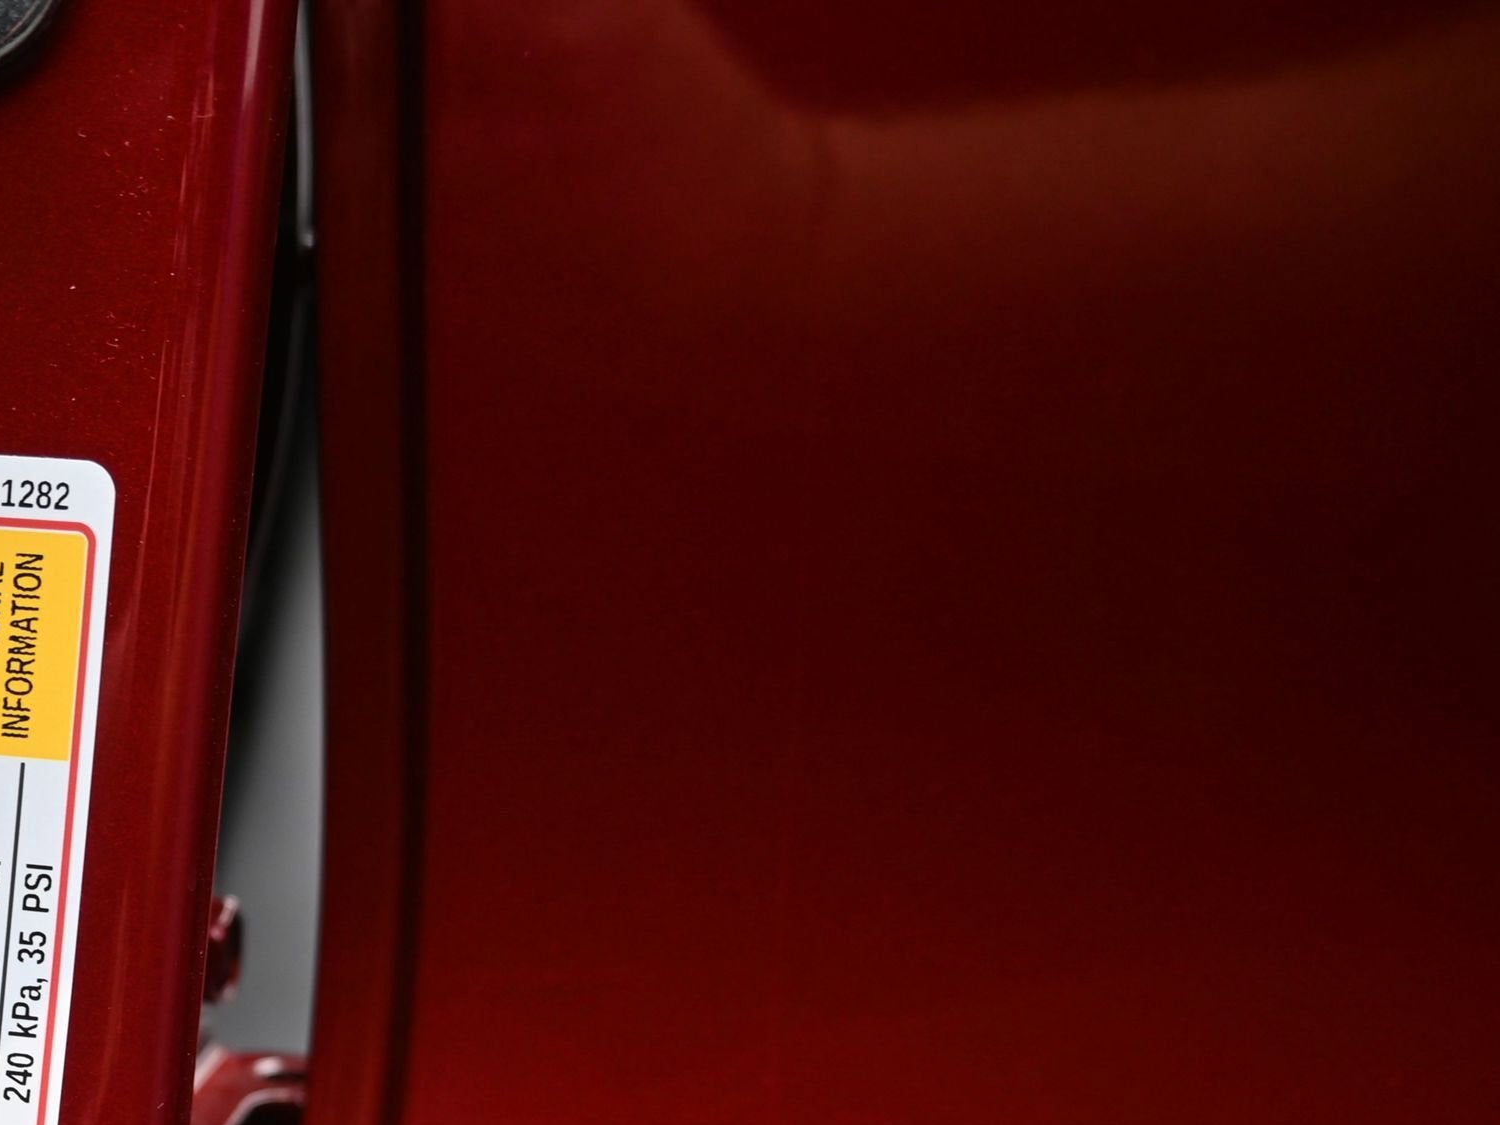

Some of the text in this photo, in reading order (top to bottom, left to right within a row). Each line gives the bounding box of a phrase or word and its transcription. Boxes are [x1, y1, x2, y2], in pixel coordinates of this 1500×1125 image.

[2, 553, 43, 738] INFORMATION
[3, 864, 53, 1103] 240 kPa, 35 PSI
